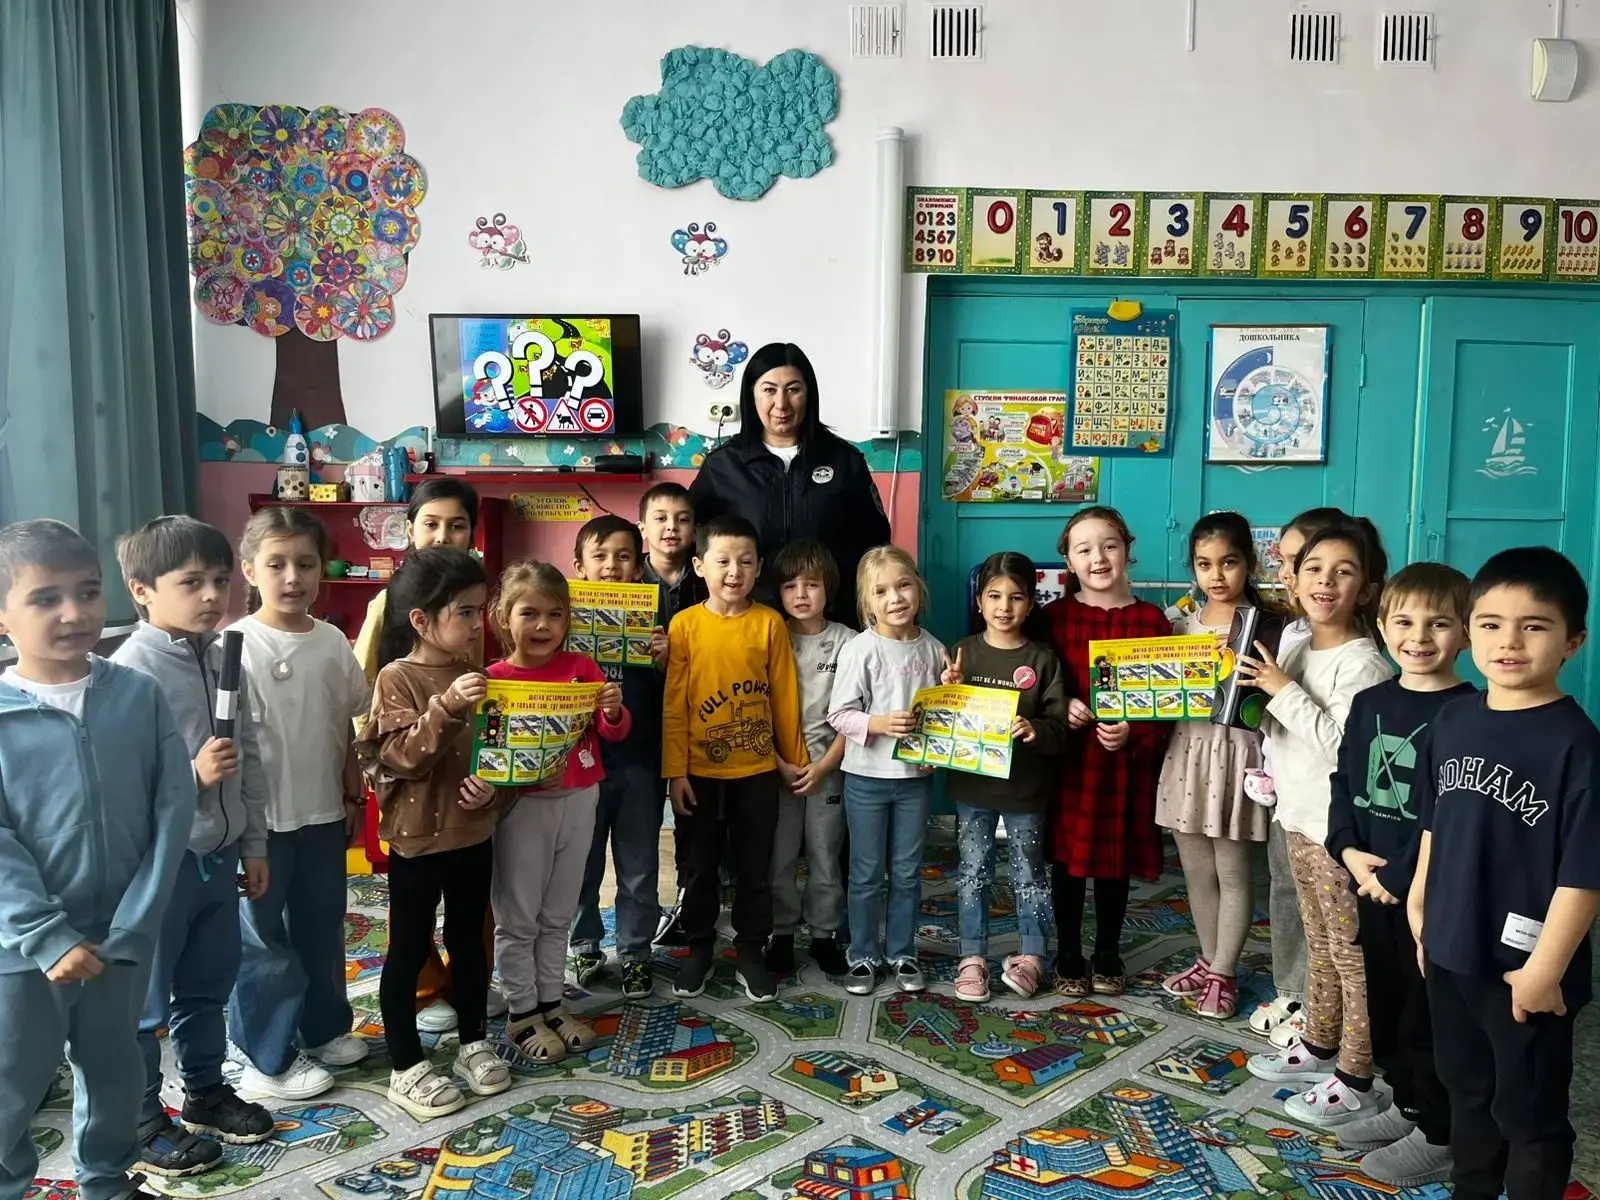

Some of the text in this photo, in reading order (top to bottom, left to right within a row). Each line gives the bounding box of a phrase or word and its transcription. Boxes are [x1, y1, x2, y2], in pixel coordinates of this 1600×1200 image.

[987, 200, 1013, 234] 0
[1053, 202, 1067, 235] 1
[1109, 203, 1131, 237] 2
[1166, 203, 1189, 237] 3
[1221, 204, 1249, 237] 4
[1285, 205, 1309, 239] 5
[1344, 206, 1368, 239] 6
[1404, 206, 1427, 240] 7
[1462, 208, 1484, 241] 8
[1520, 209, 1542, 242] 9
[1561, 210, 1598, 243] 10
[1080, 338, 1086, 346] А
[1098, 338, 1104, 347] Б
[1116, 338, 1122, 347] В
[1152, 340, 1160, 348] Д
[1239, 334, 1301, 342] ДОШКОЛЬНИКА
[1080, 354, 1085, 362] Е
[1115, 354, 1123, 362] Ж
[1134, 354, 1139, 362] З
[1115, 370, 1121, 378] Л
[1132, 370, 1140, 378] М
[1077, 385, 1084, 393] О
[1133, 386, 1138, 394] С
[1077, 401, 1083, 409] У
[1095, 401, 1102, 409] Ф
[1132, 402, 1139, 411] Ц
[1075, 417, 1084, 425] Ш
[1093, 418, 1102, 426] Щ
[1075, 433, 1080, 441] Э
[1093, 433, 1101, 441] Ю
[699, 690, 728, 723] FULL
